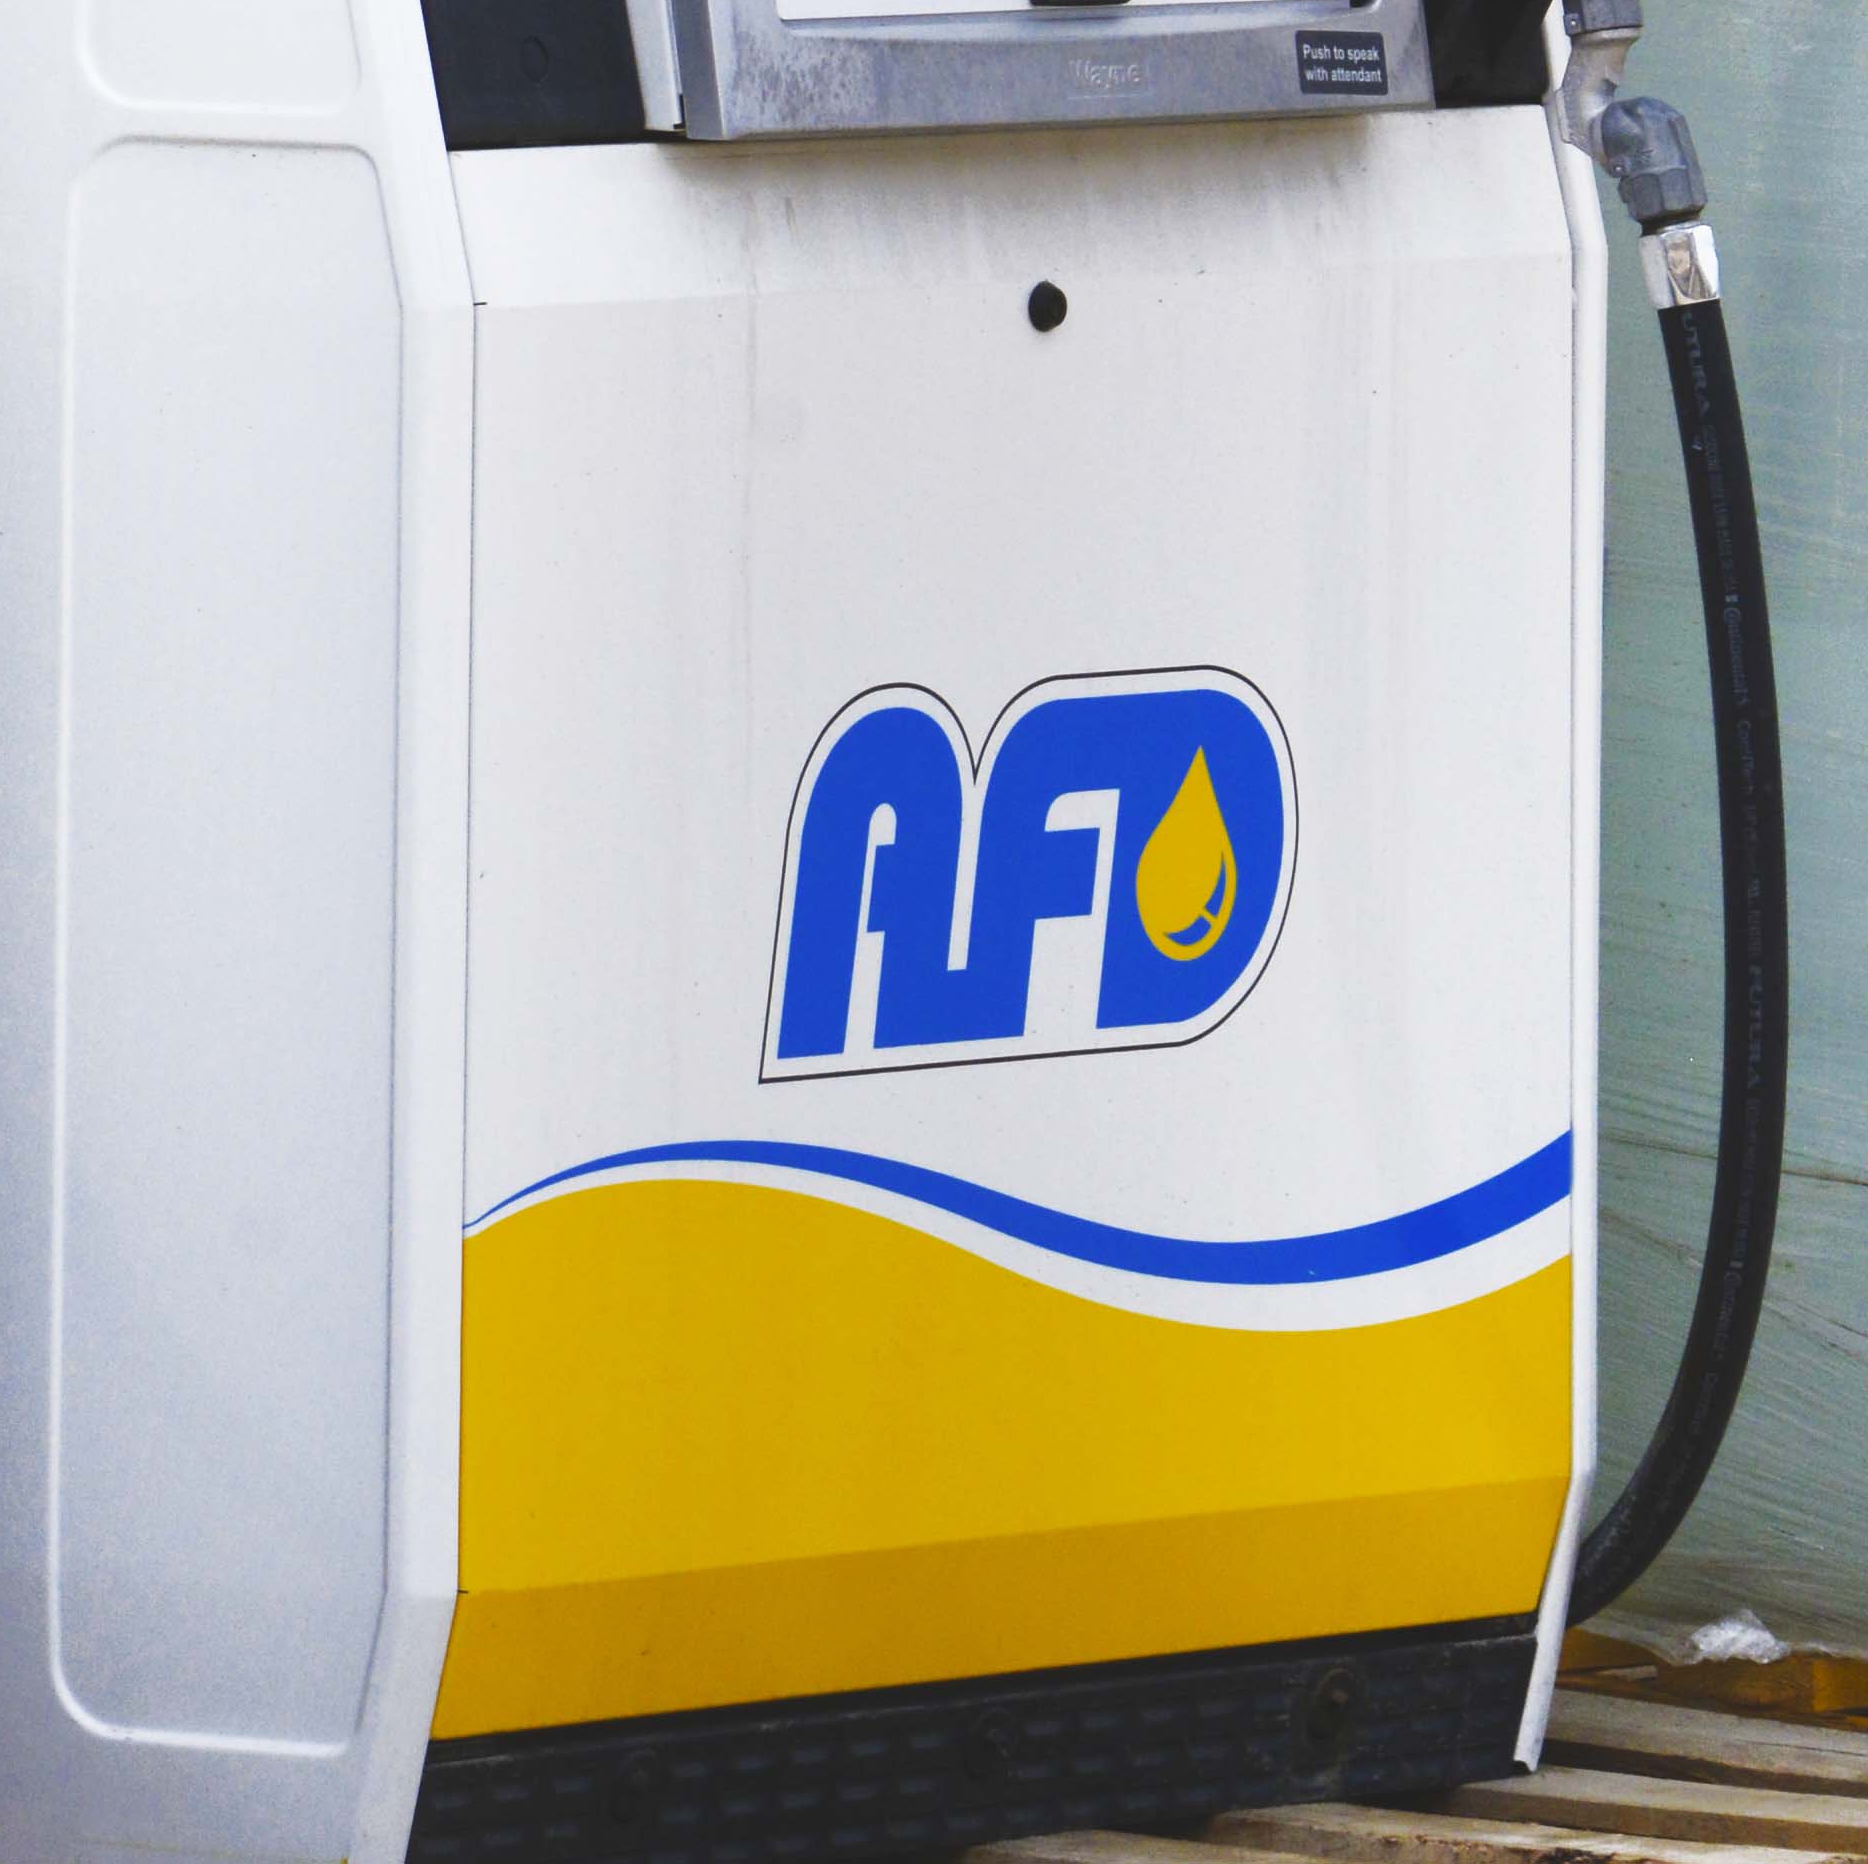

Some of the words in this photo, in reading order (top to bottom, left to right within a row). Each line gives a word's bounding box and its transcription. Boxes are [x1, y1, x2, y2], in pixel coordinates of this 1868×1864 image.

[1302, 43, 1332, 60] Push
[1333, 45, 1345, 61] to
[1347, 45, 1380, 65] speak
[1304, 65, 1329, 81] with
[1331, 65, 1382, 83] attendant
